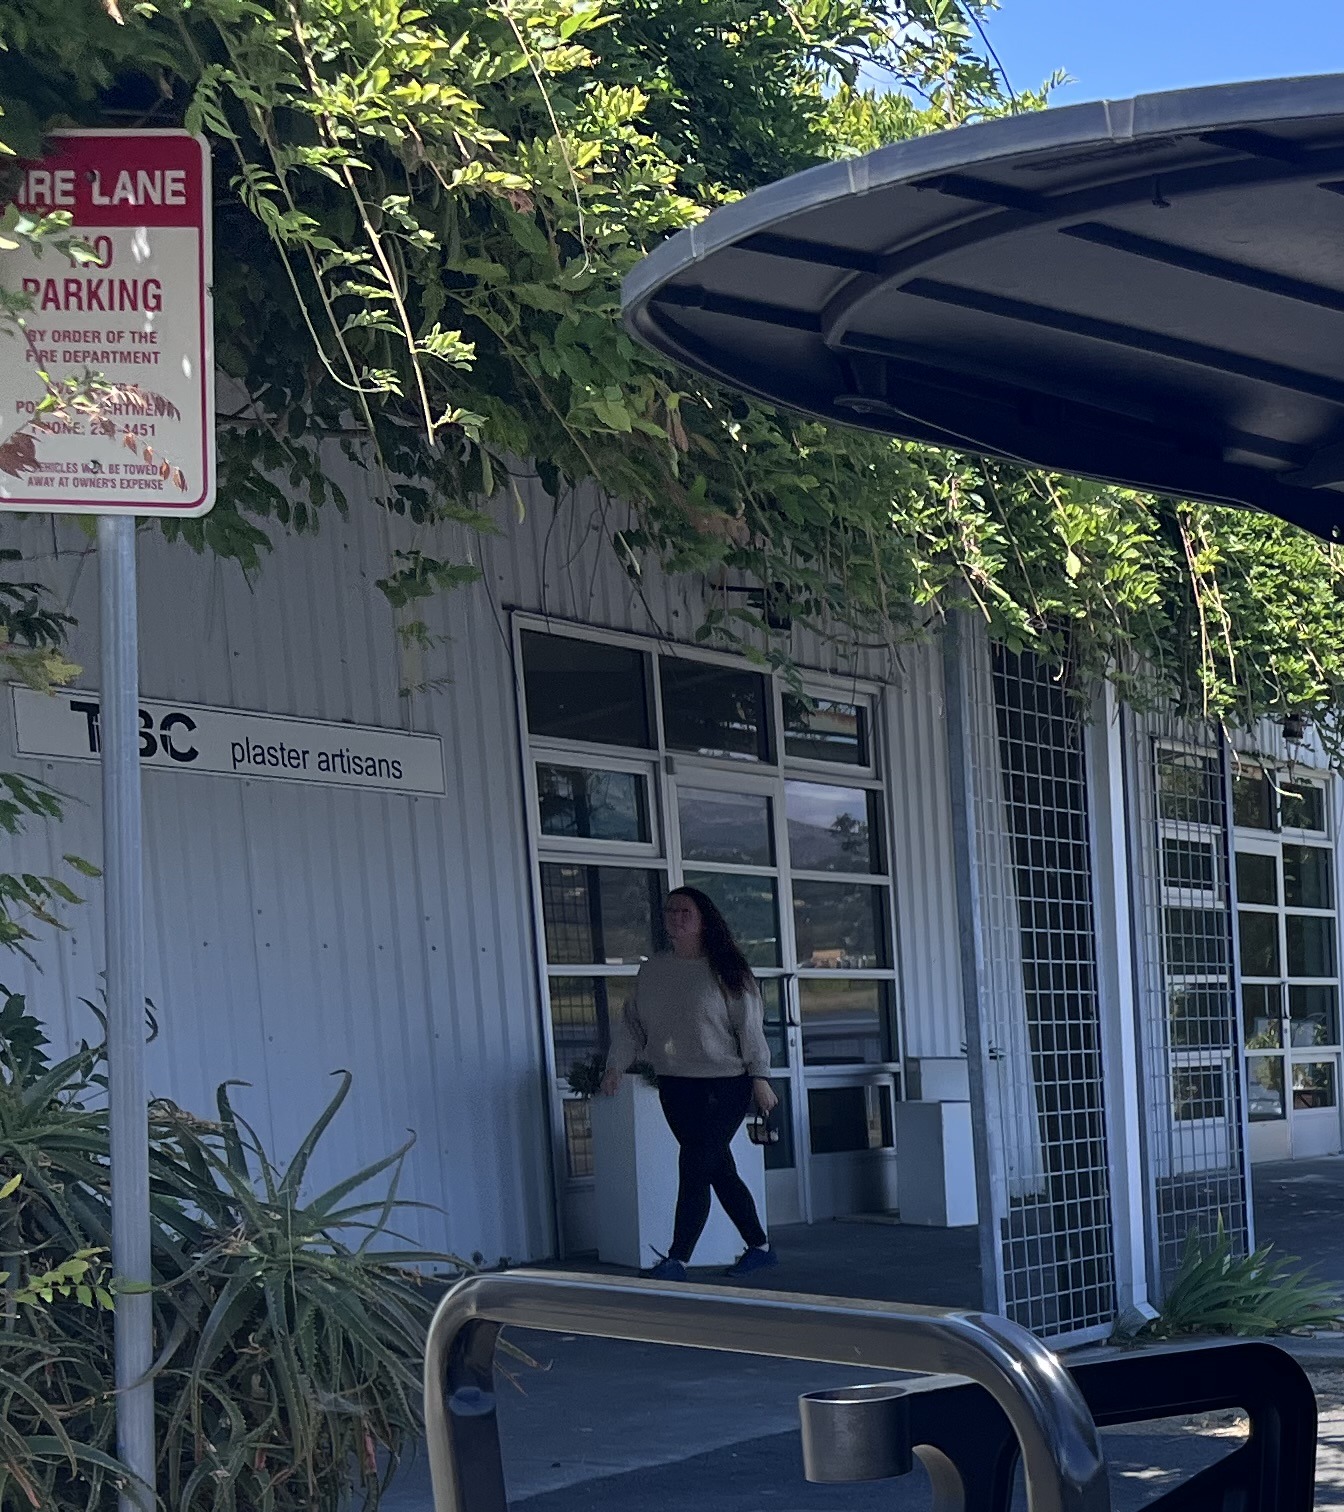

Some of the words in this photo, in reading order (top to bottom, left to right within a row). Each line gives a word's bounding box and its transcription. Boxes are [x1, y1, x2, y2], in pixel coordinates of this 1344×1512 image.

[91, 170, 186, 205] LANE
[22, 278, 162, 312] PARKING
[51, 330, 101, 343] ORDER
[106, 330, 125, 344] OF
[130, 331, 158, 344] THE
[62, 350, 161, 364] DEPARTMENT
[108, 464, 120, 474] BE
[123, 464, 158, 475] TOWED
[27, 477, 55, 487] AWAY
[58, 477, 69, 487] AT
[72, 477, 116, 488] OWNER'S
[120, 478, 163, 490] EXPENSE
[231, 736, 310, 770] plaster
[317, 748, 403, 780] artisans
